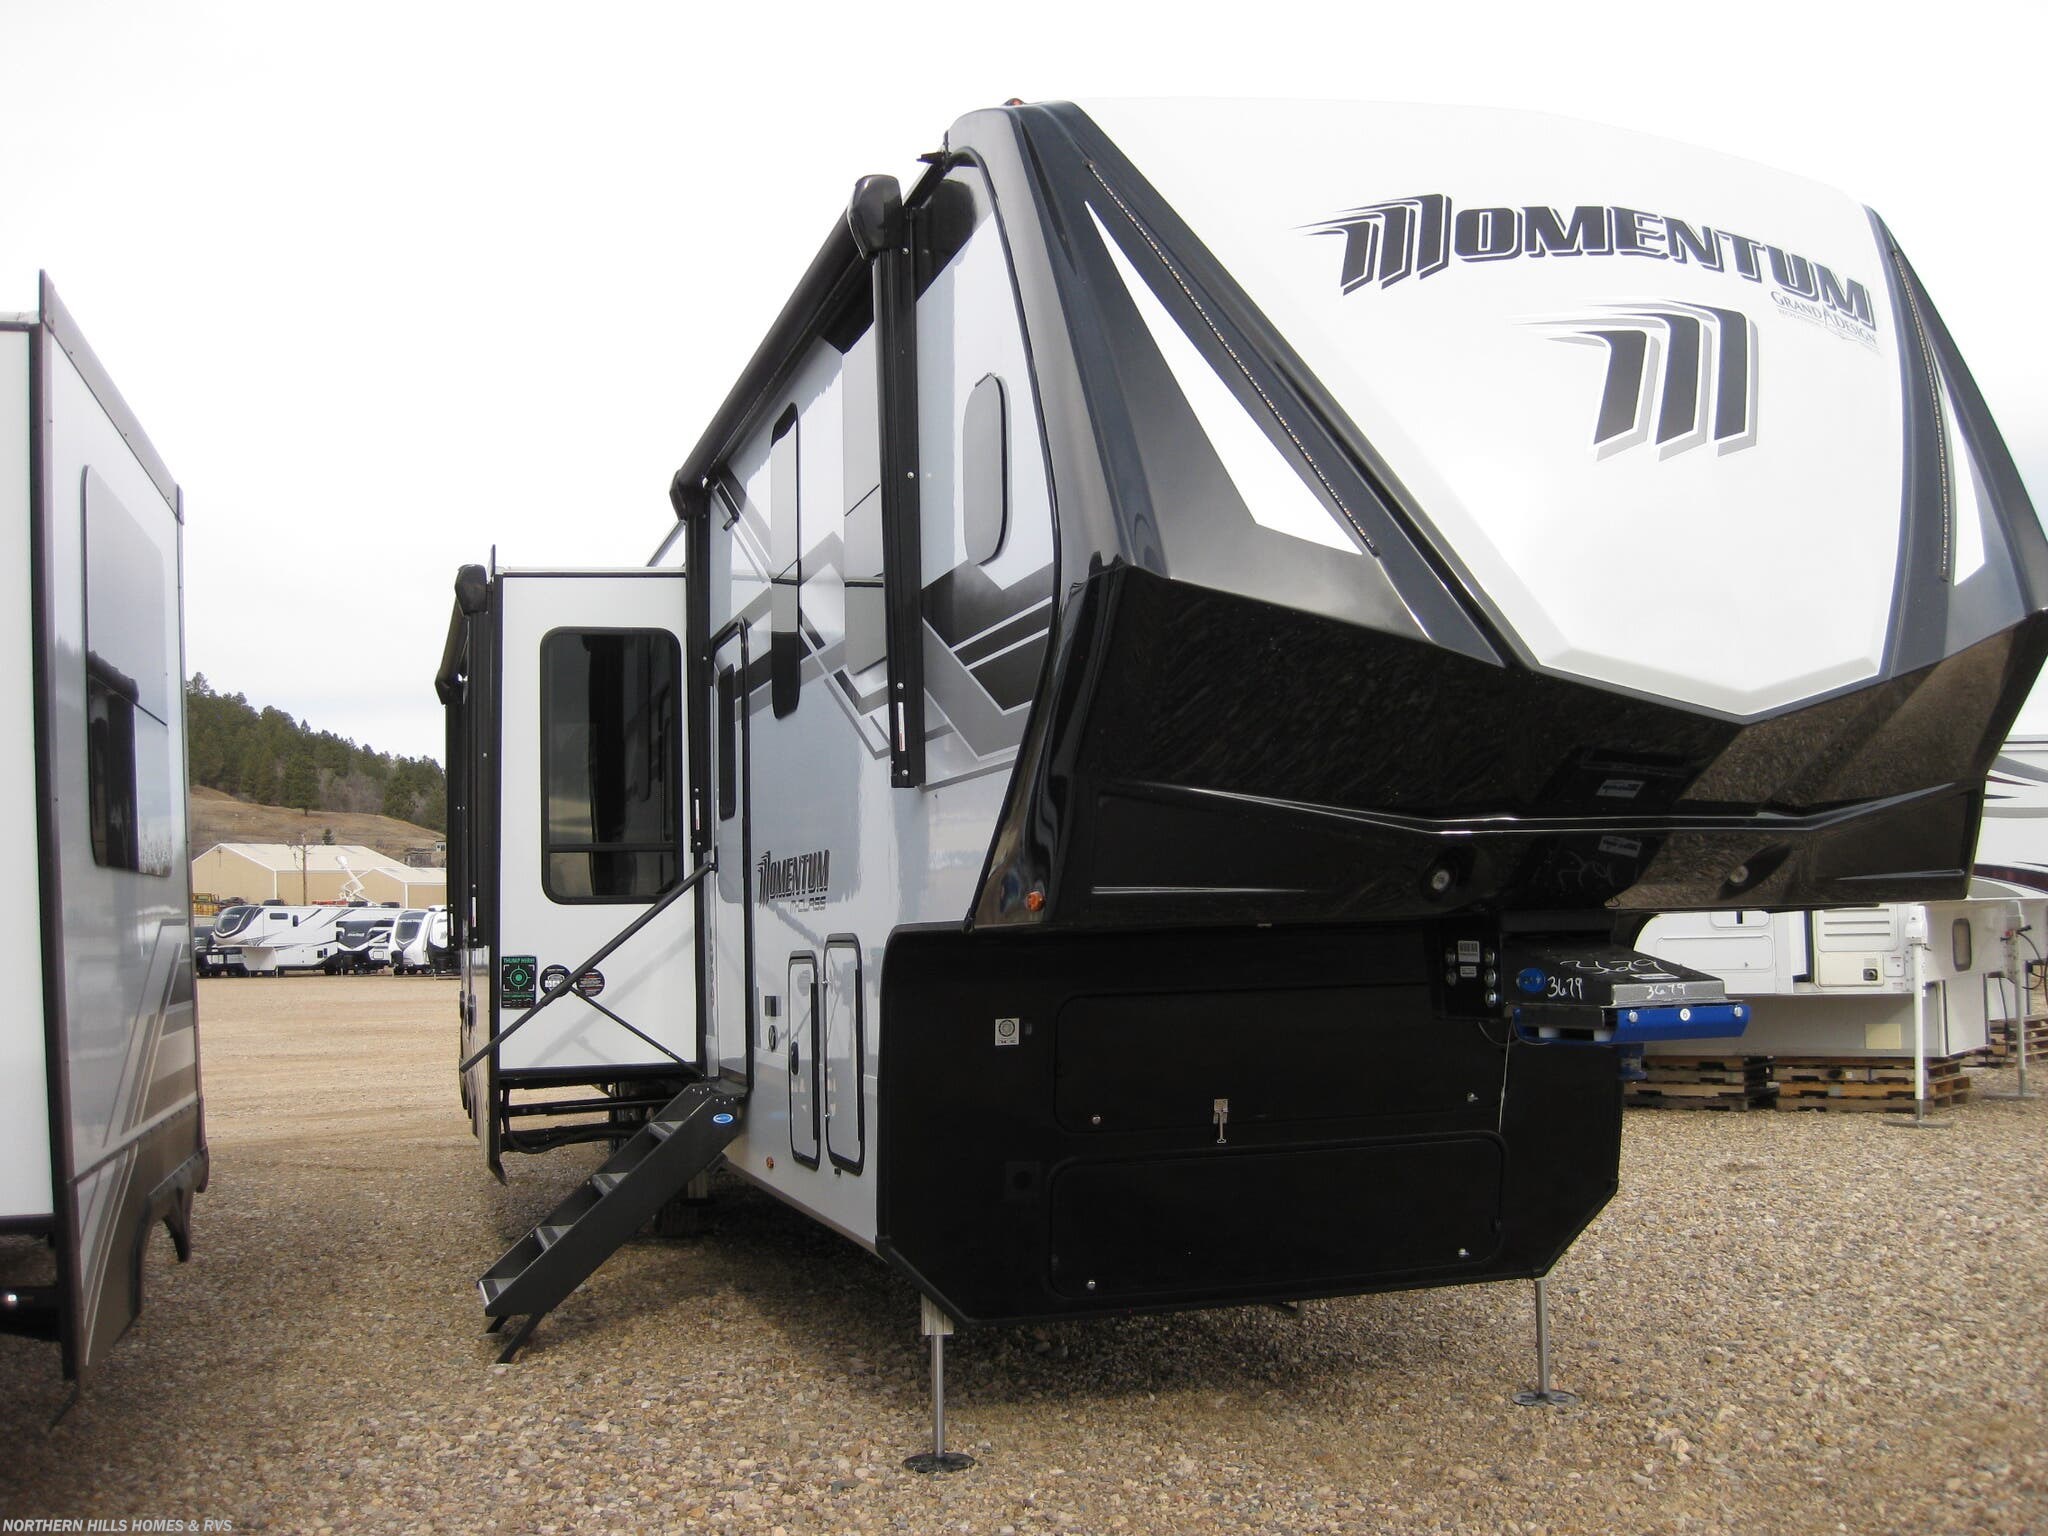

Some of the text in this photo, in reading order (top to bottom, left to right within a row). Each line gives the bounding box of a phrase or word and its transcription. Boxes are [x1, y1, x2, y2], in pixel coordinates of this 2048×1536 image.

[1292, 192, 1877, 331] MOMENTUM
[1770, 290, 1823, 320] GRAND
[1837, 312, 1878, 345] DESIGN
[757, 848, 830, 910] MOMENTUM
[1547, 975, 1583, 999] 3679
[1646, 983, 1687, 999] 3679
